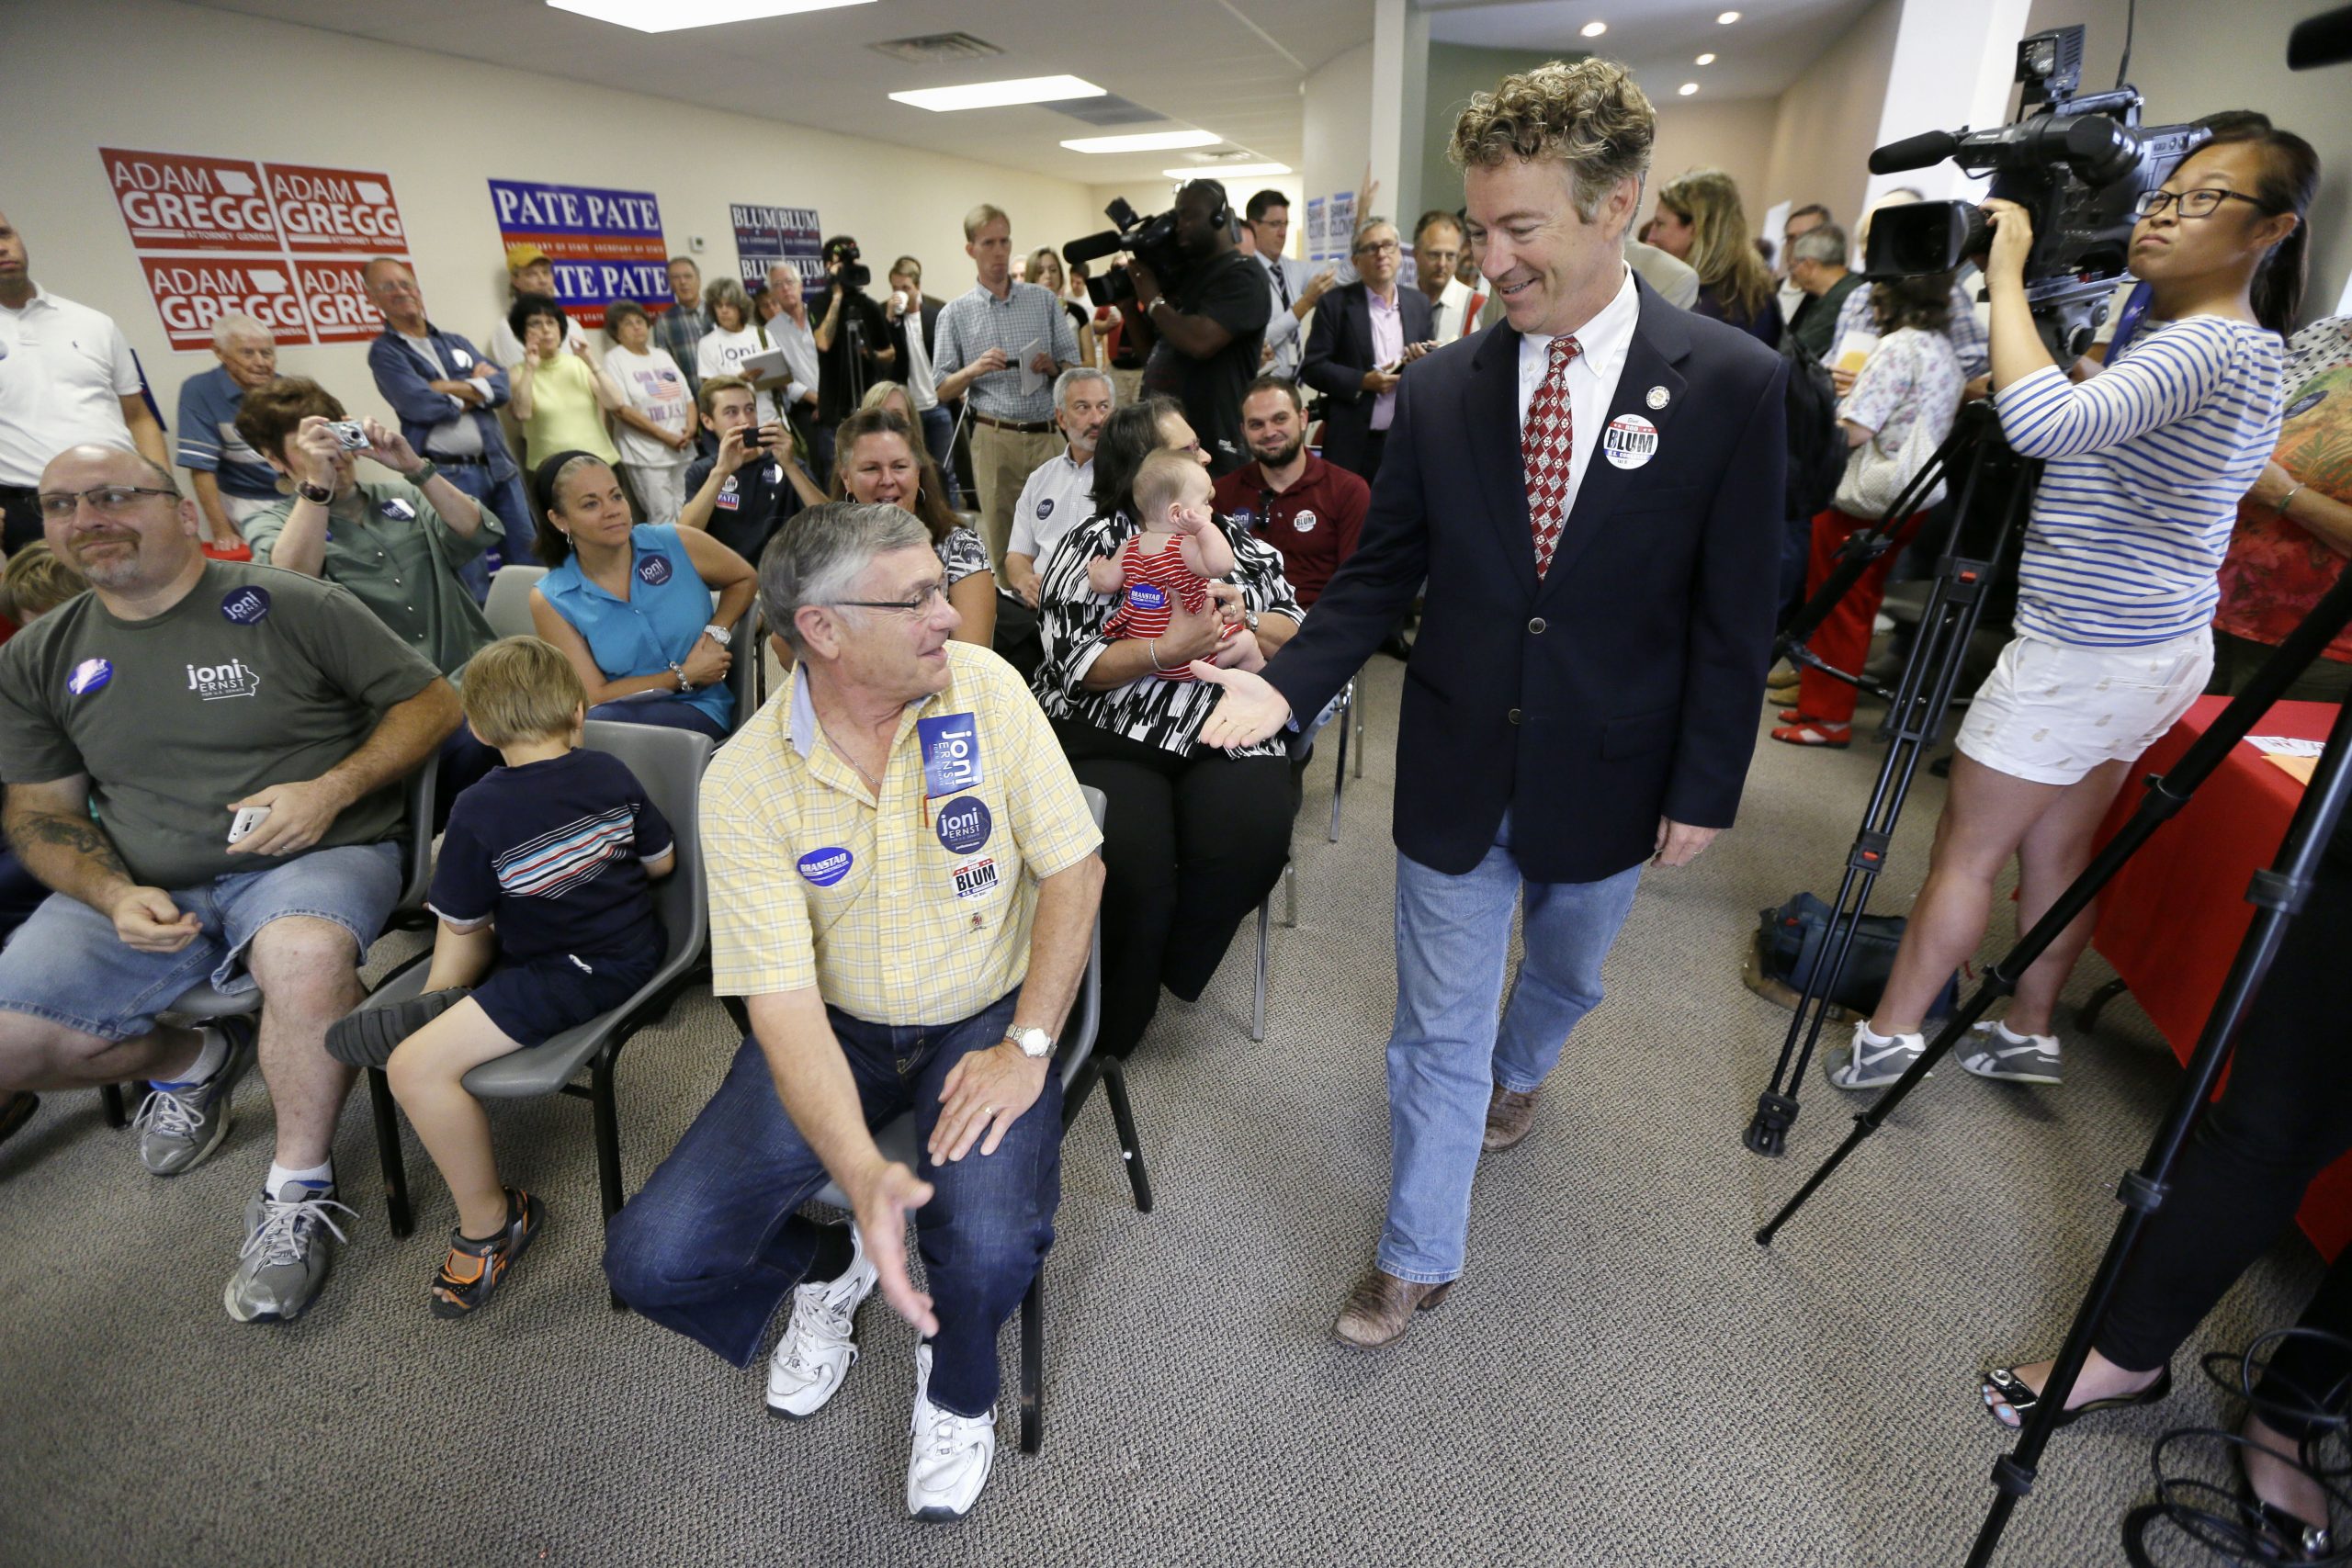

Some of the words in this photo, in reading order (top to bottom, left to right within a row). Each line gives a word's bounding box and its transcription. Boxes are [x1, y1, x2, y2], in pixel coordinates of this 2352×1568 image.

[115, 161, 213, 194] ADAM
[275, 174, 354, 203] ADAM
[121, 191, 274, 231] GREGG
[278, 200, 401, 236] GREGG
[494, 188, 583, 227] PATE
[585, 195, 659, 230] PATE
[733, 207, 776, 230] BLUM
[778, 209, 820, 231] BLUM
[185, 231, 233, 242] ATTORNEY
[236, 232, 277, 243] GENERAL
[330, 235, 370, 245] ATTORNEY
[372, 237, 405, 247] GENERAL
[153, 268, 248, 295] ADAM
[553, 265, 599, 298] TE
[600, 266, 672, 298] PATE
[741, 260, 770, 280] BLU
[160, 294, 305, 330] GREGG
[310, 293, 387, 325] GRE
[1607, 429, 1655, 454] BLUM
[718, 494, 737, 502] PATE
[1296, 516, 1315, 526] BLUM
[639, 558, 662, 581] joni
[223, 591, 258, 620] joni
[187, 658, 243, 690] joni
[199, 678, 244, 693] ERNST
[939, 741, 956, 785] ERNST
[942, 730, 978, 784] joni
[941, 807, 979, 836] joni
[949, 824, 980, 839] ERNST
[800, 852, 847, 873] BRANSTAD
[956, 863, 997, 892] BLUM
